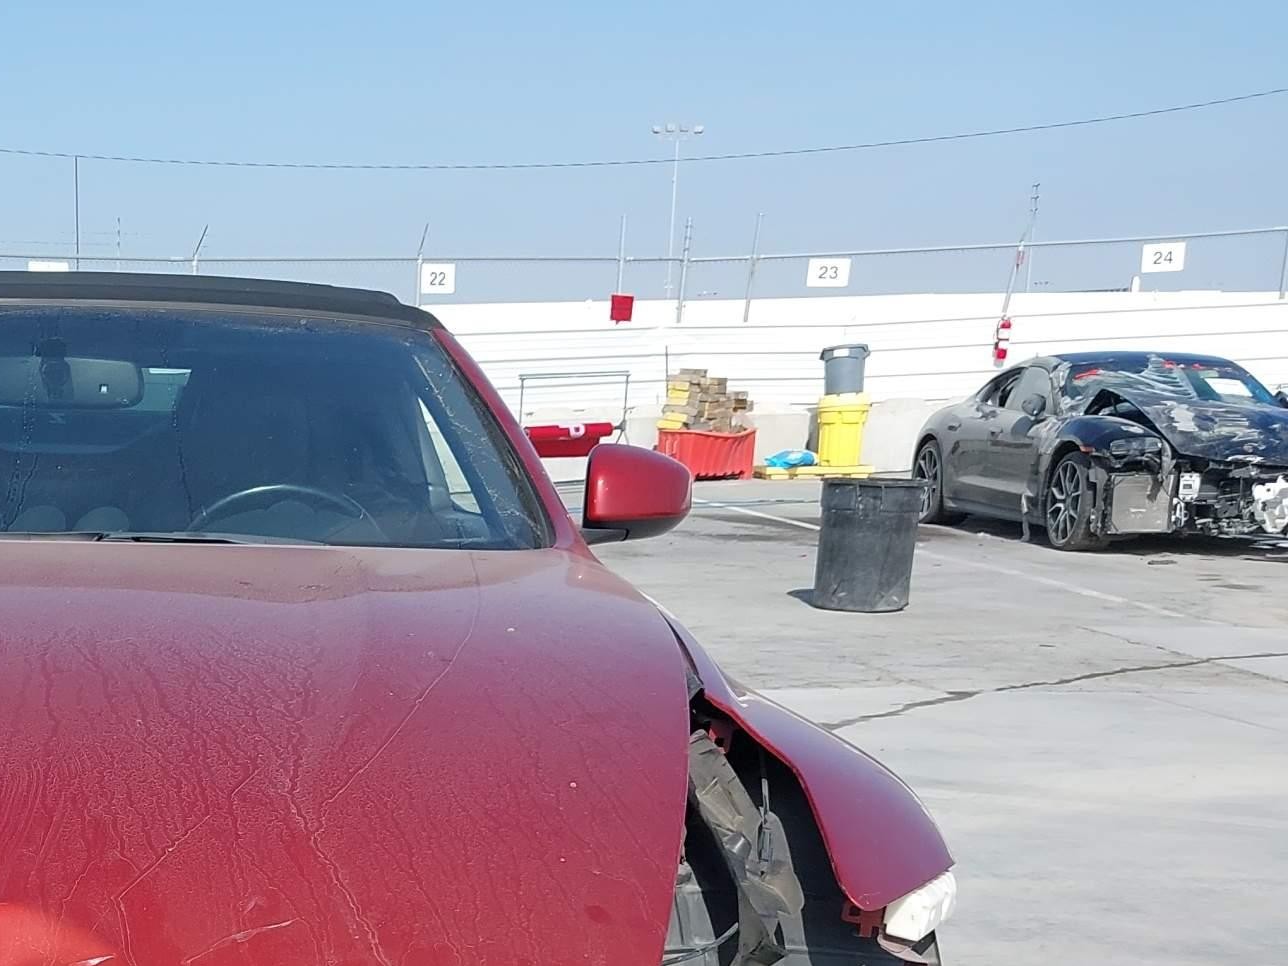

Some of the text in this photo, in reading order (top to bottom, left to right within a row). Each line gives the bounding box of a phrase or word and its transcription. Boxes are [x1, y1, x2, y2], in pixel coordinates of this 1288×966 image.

[1153, 250, 1173, 265] 24
[429, 271, 446, 286] 22
[818, 265, 839, 280] 23
